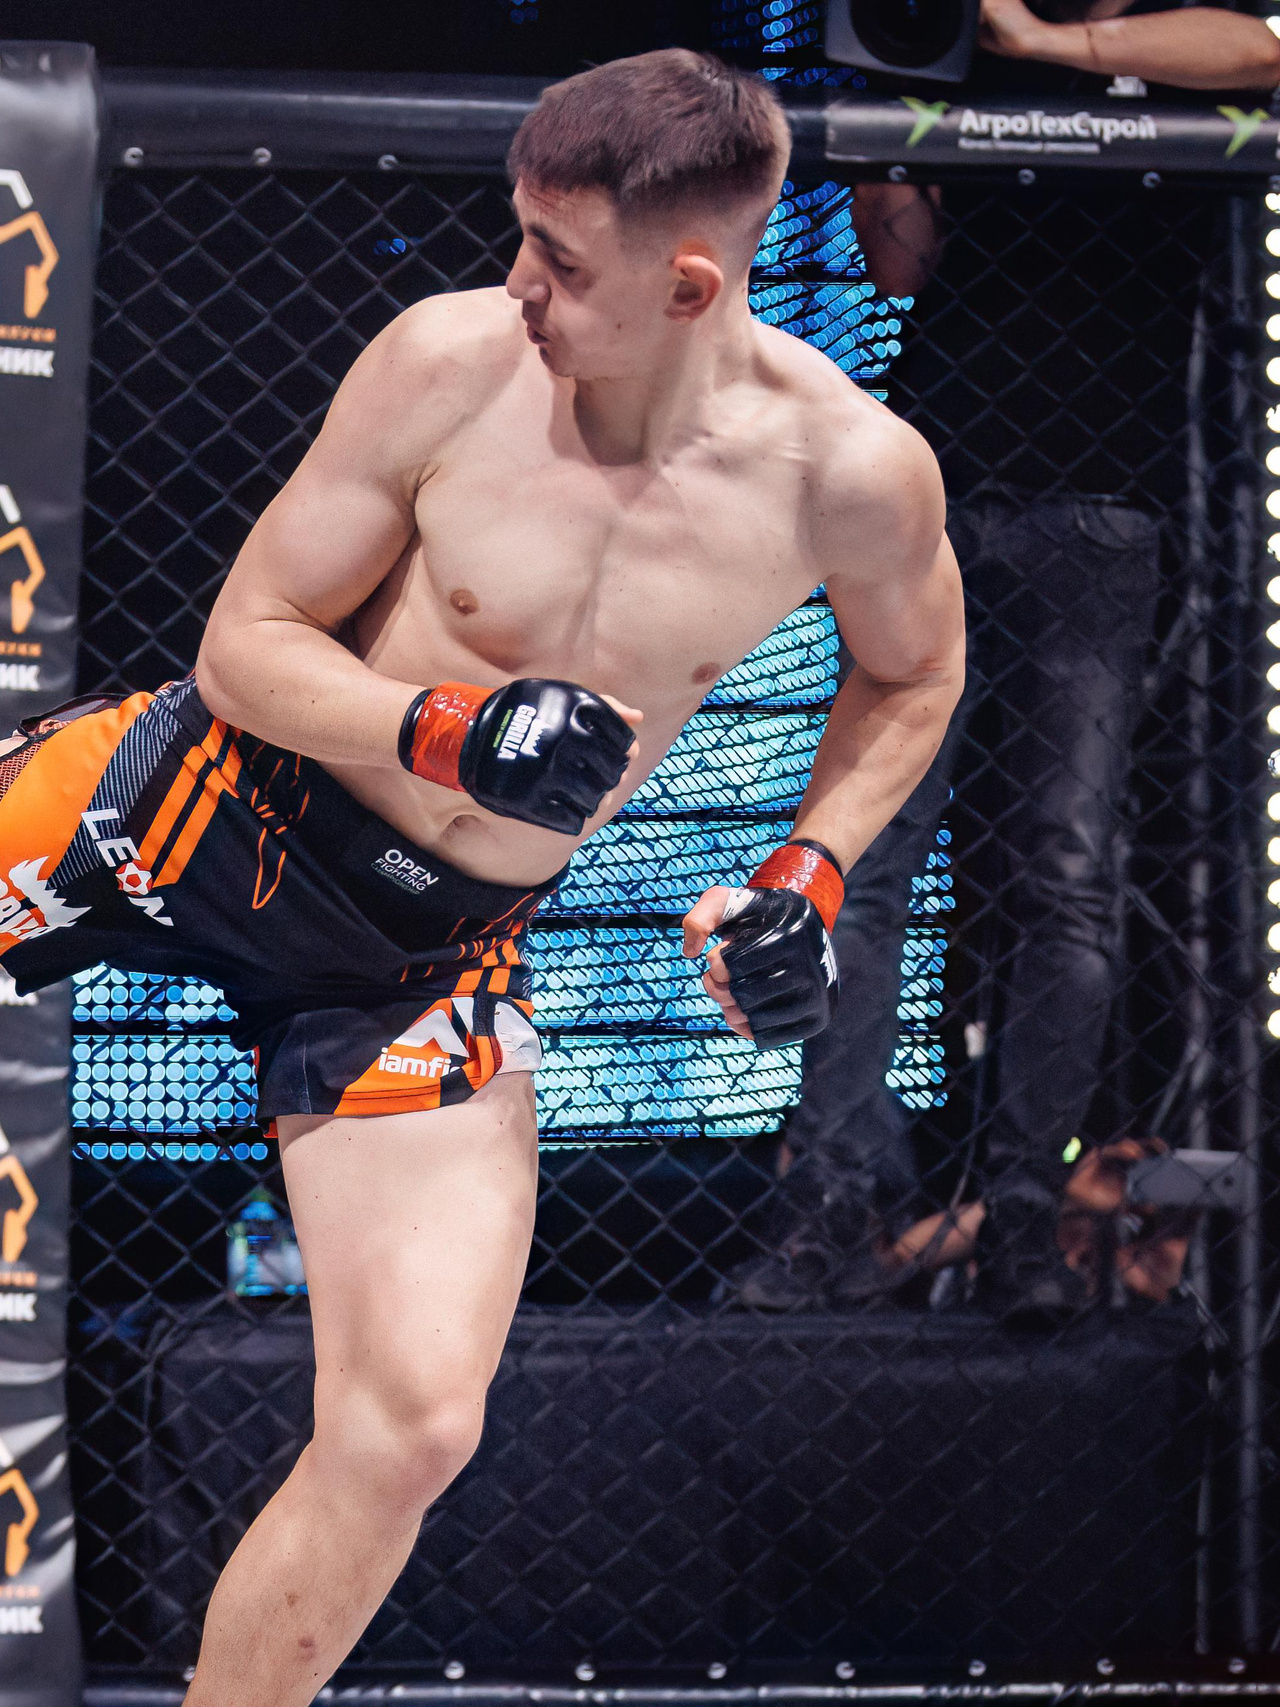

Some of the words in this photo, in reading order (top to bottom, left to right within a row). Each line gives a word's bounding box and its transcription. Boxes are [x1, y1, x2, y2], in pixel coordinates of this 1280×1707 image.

[959, 109, 1157, 143] АгроТехСтрой
[497, 704, 537, 760] GORILLA
[375, 857, 427, 891] FIGHTING
[384, 849, 439, 886] OPEN
[378, 1047, 461, 1078] iamfi
